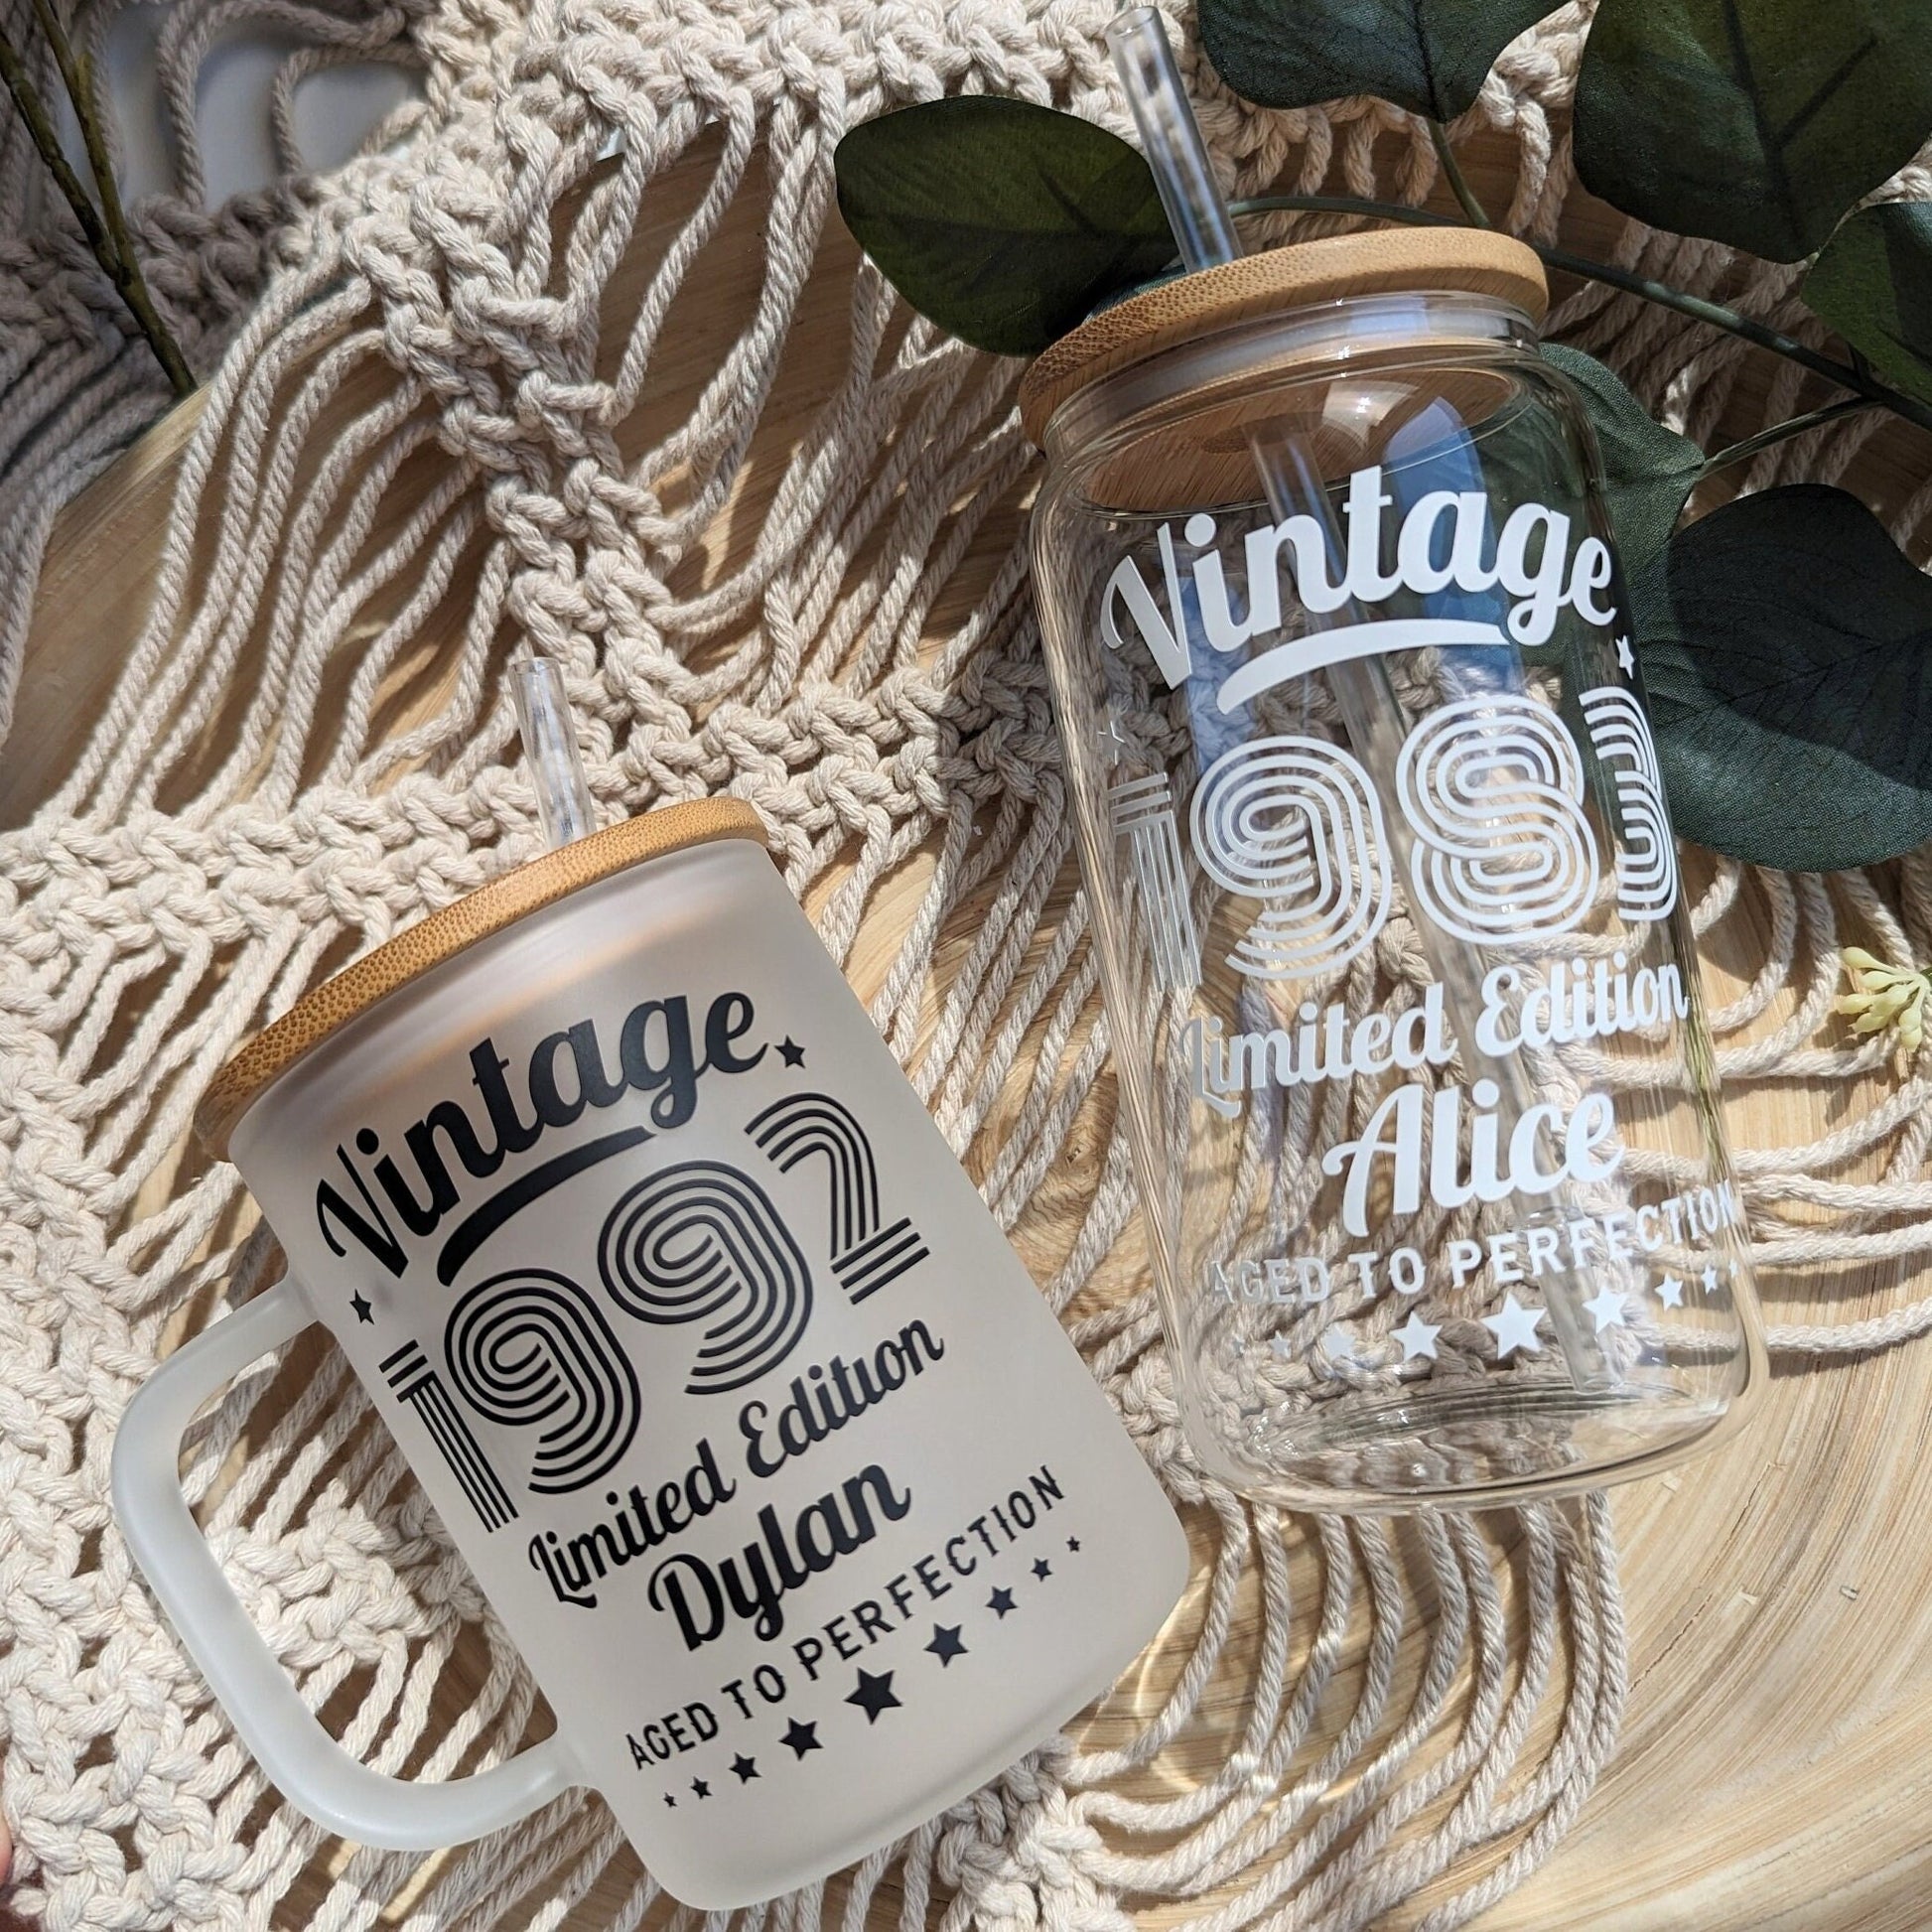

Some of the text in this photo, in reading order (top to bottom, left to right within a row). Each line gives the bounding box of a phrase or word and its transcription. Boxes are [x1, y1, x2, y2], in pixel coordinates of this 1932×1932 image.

[1099, 466, 1617, 690] Vintage
[317, 992, 768, 1279] Vintage
[1180, 951, 1689, 1119] Limited Edition
[1210, 1179, 1737, 1305] AGED TO PERFECTION
[1322, 1078, 1625, 1238] Alice
[379, 1093, 930, 1532] 1992
[528, 1319, 944, 1608] Limited Edition
[648, 1463, 911, 1651] Dylan
[625, 1465, 1065, 1771] AGED TO PERFECTION
